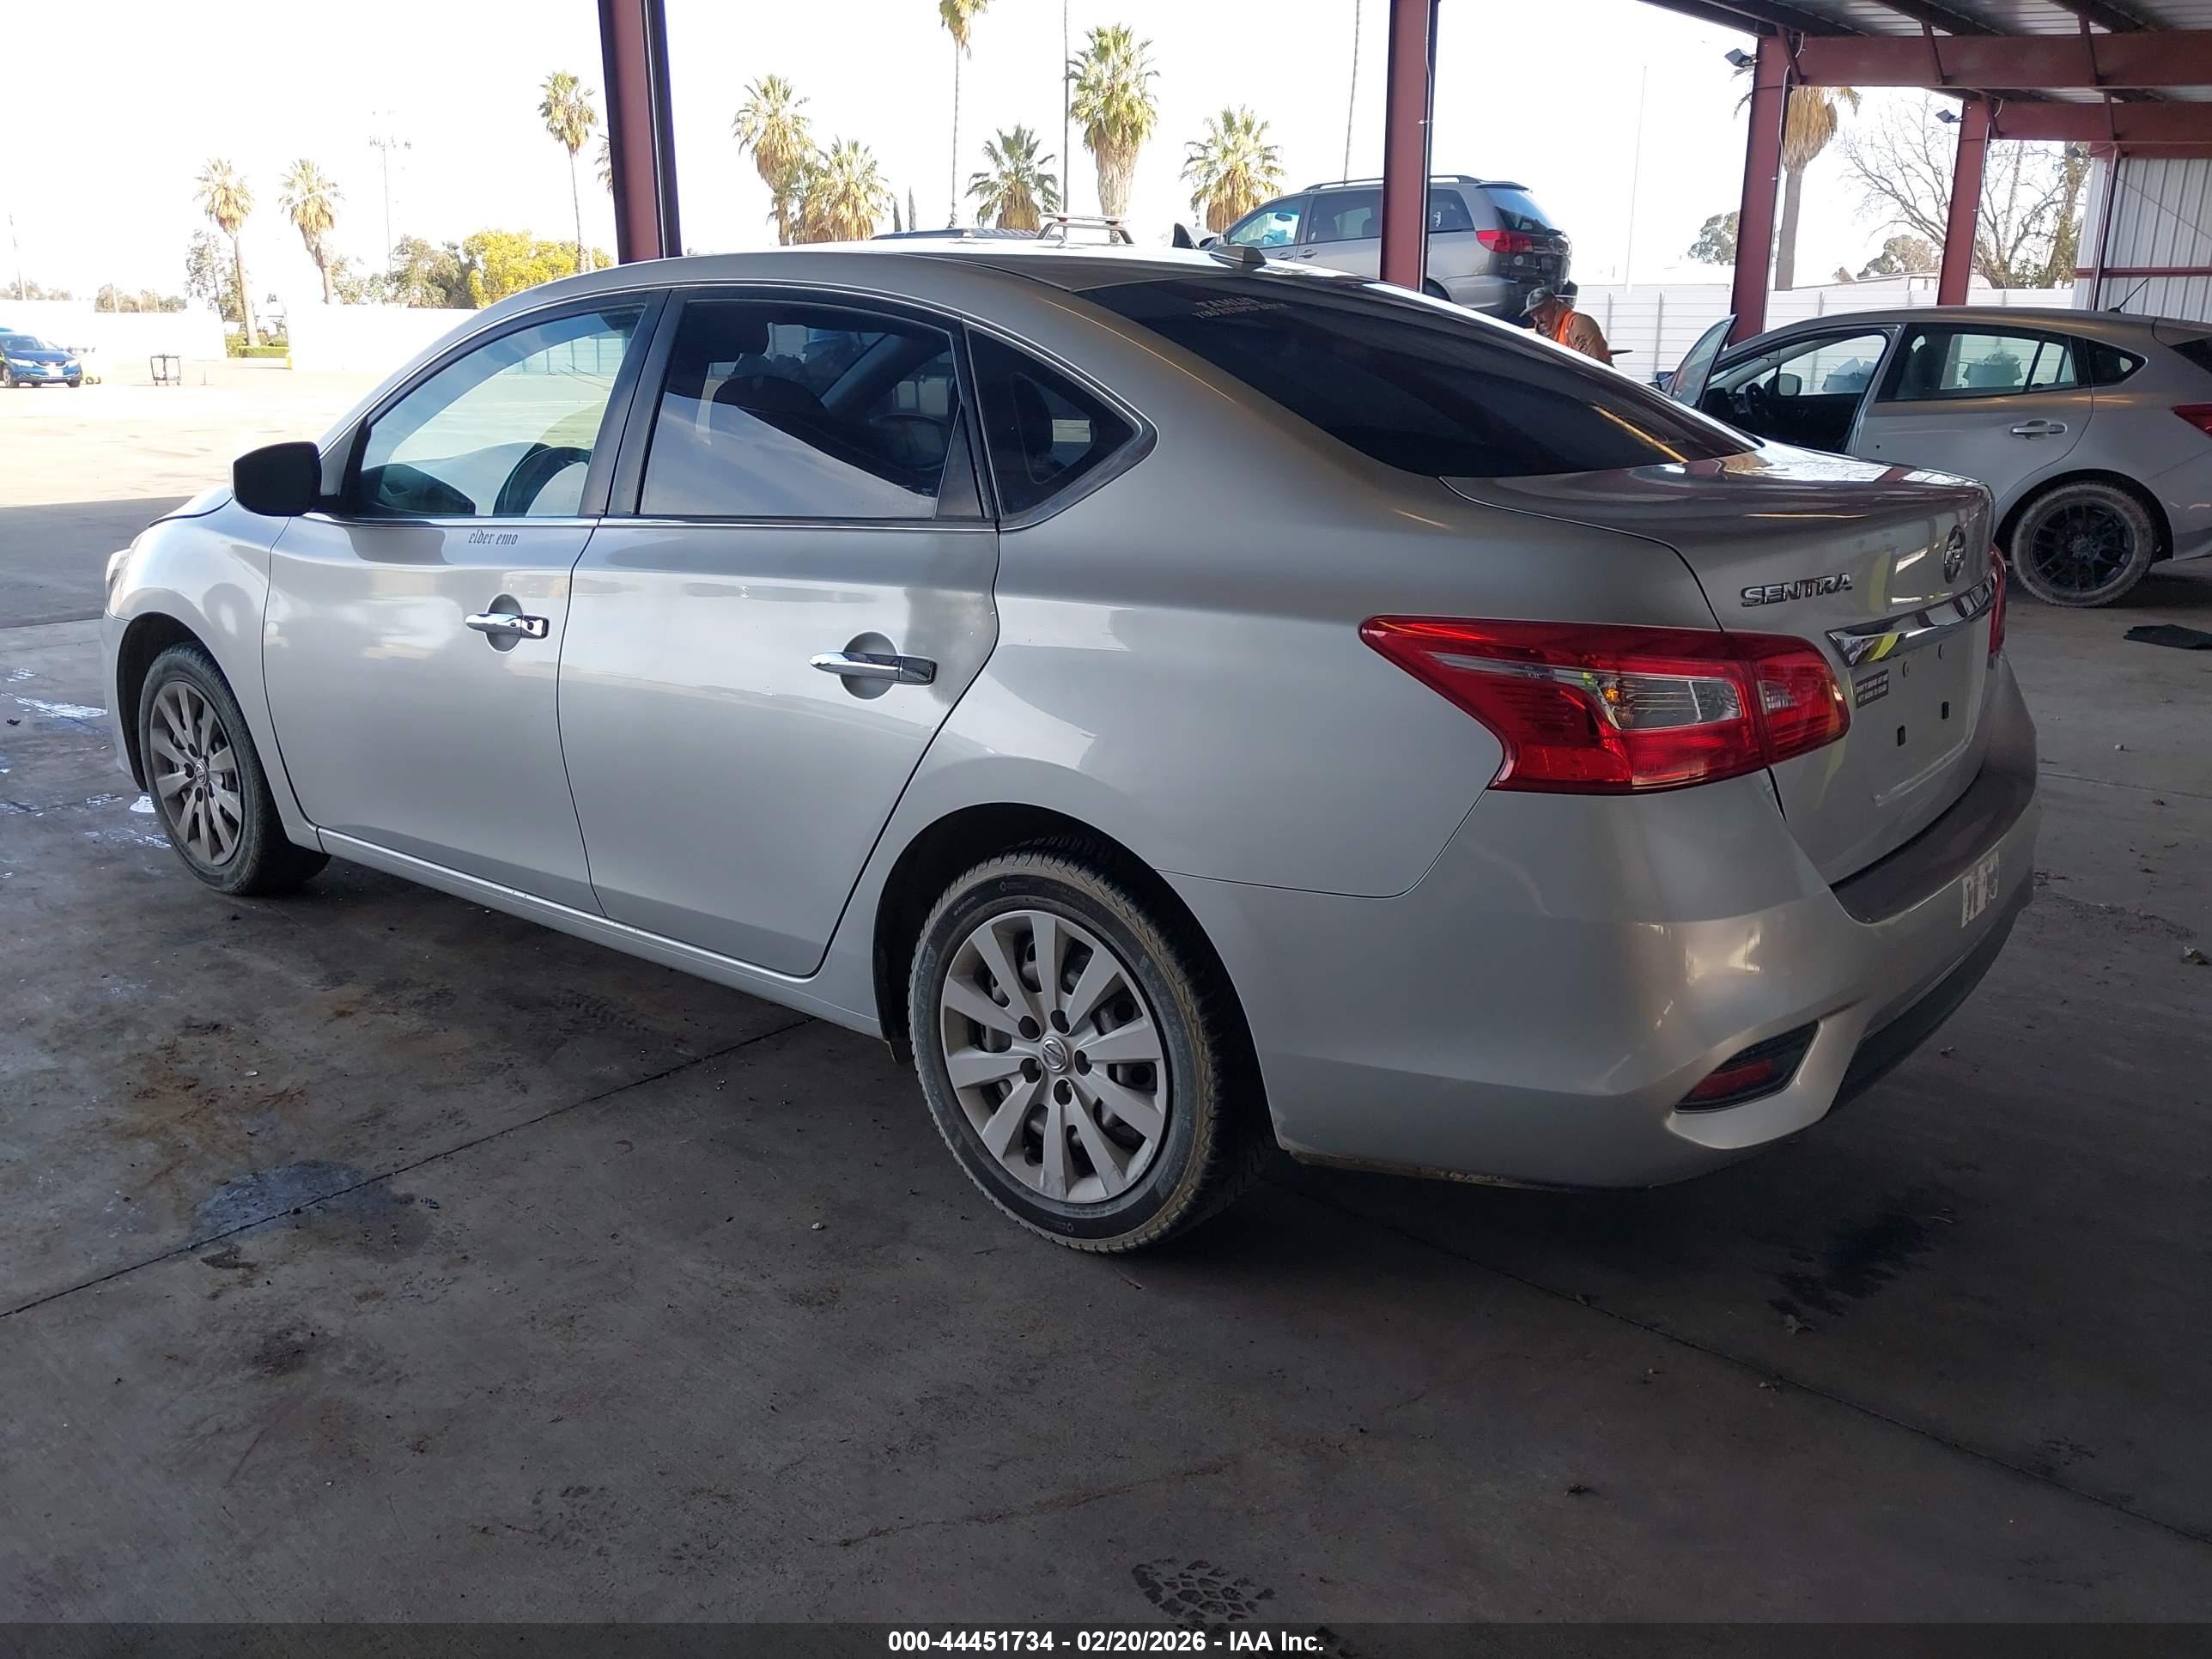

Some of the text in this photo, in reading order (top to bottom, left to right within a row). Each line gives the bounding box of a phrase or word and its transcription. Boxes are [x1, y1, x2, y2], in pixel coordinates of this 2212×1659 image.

[468, 529, 519, 546] elder emo
[1741, 573, 1853, 608] SENTRA
